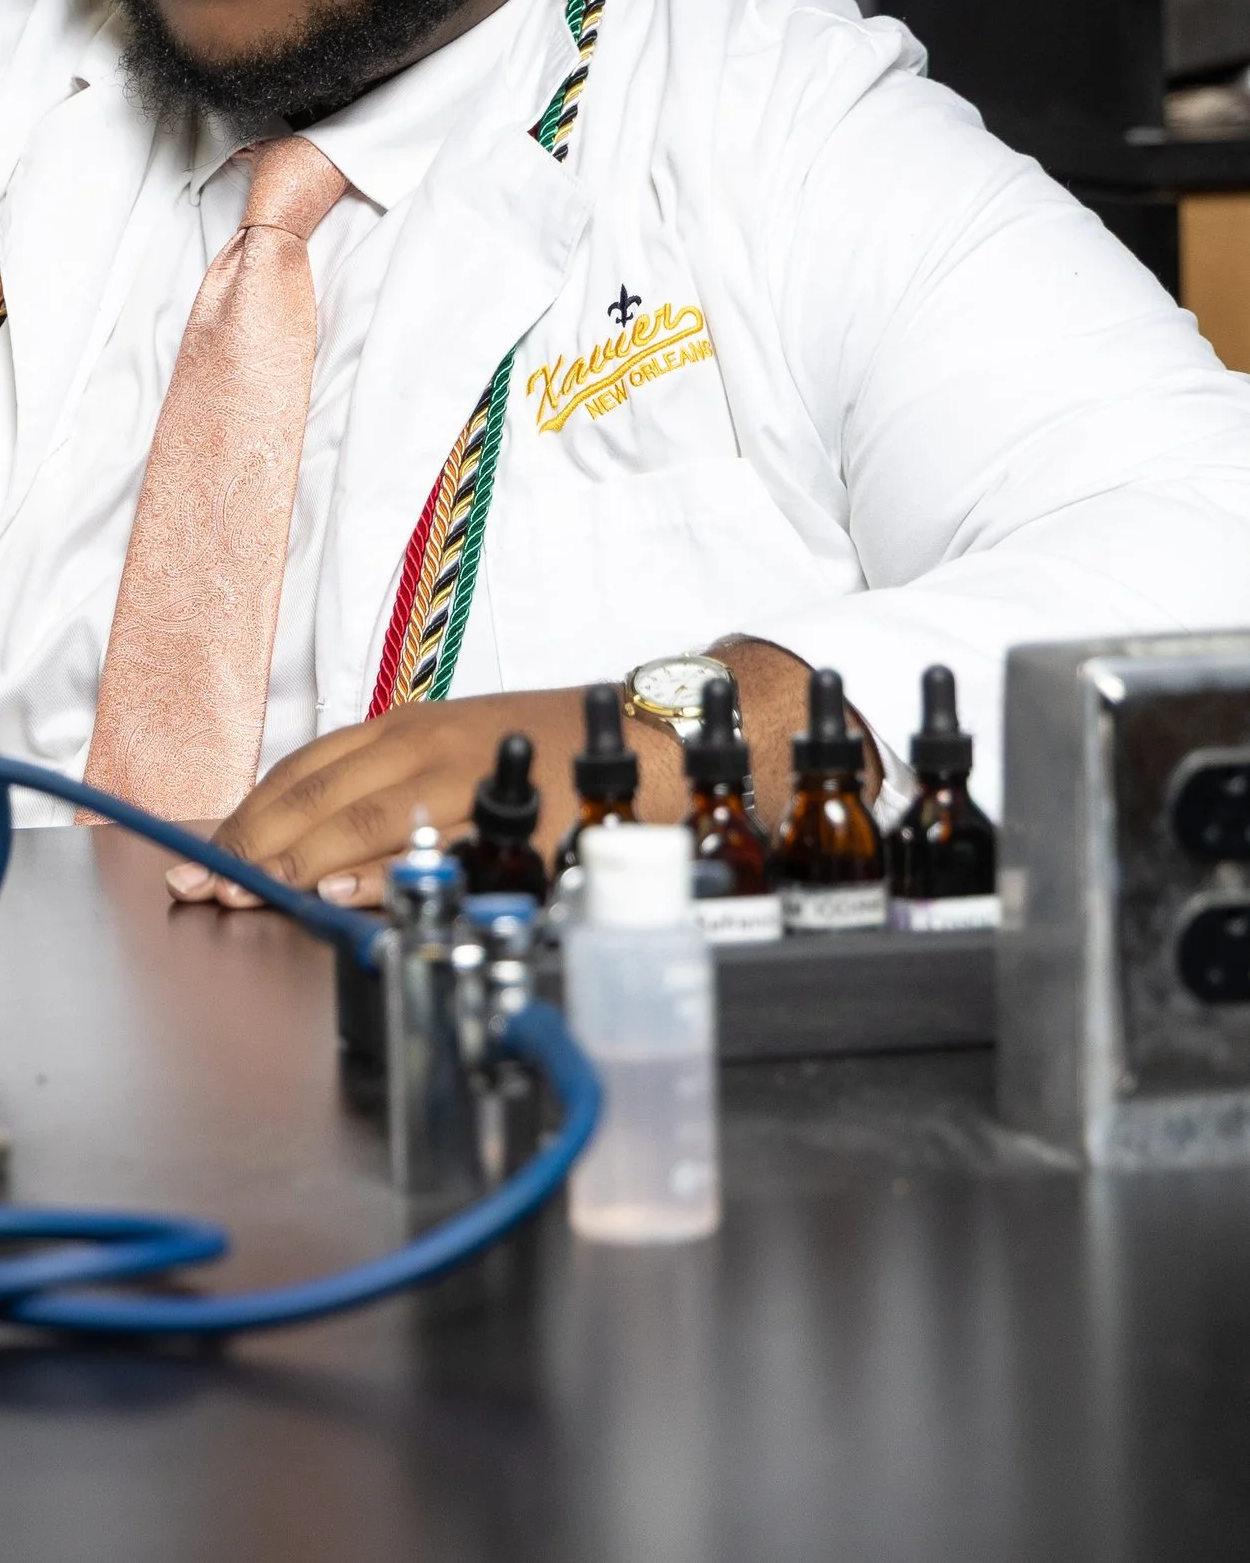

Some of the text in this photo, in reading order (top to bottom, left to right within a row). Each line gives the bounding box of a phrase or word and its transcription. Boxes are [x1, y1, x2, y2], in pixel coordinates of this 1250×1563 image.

[525, 303, 703, 426] Xavier
[585, 339, 713, 420] NEW ORLEANS
